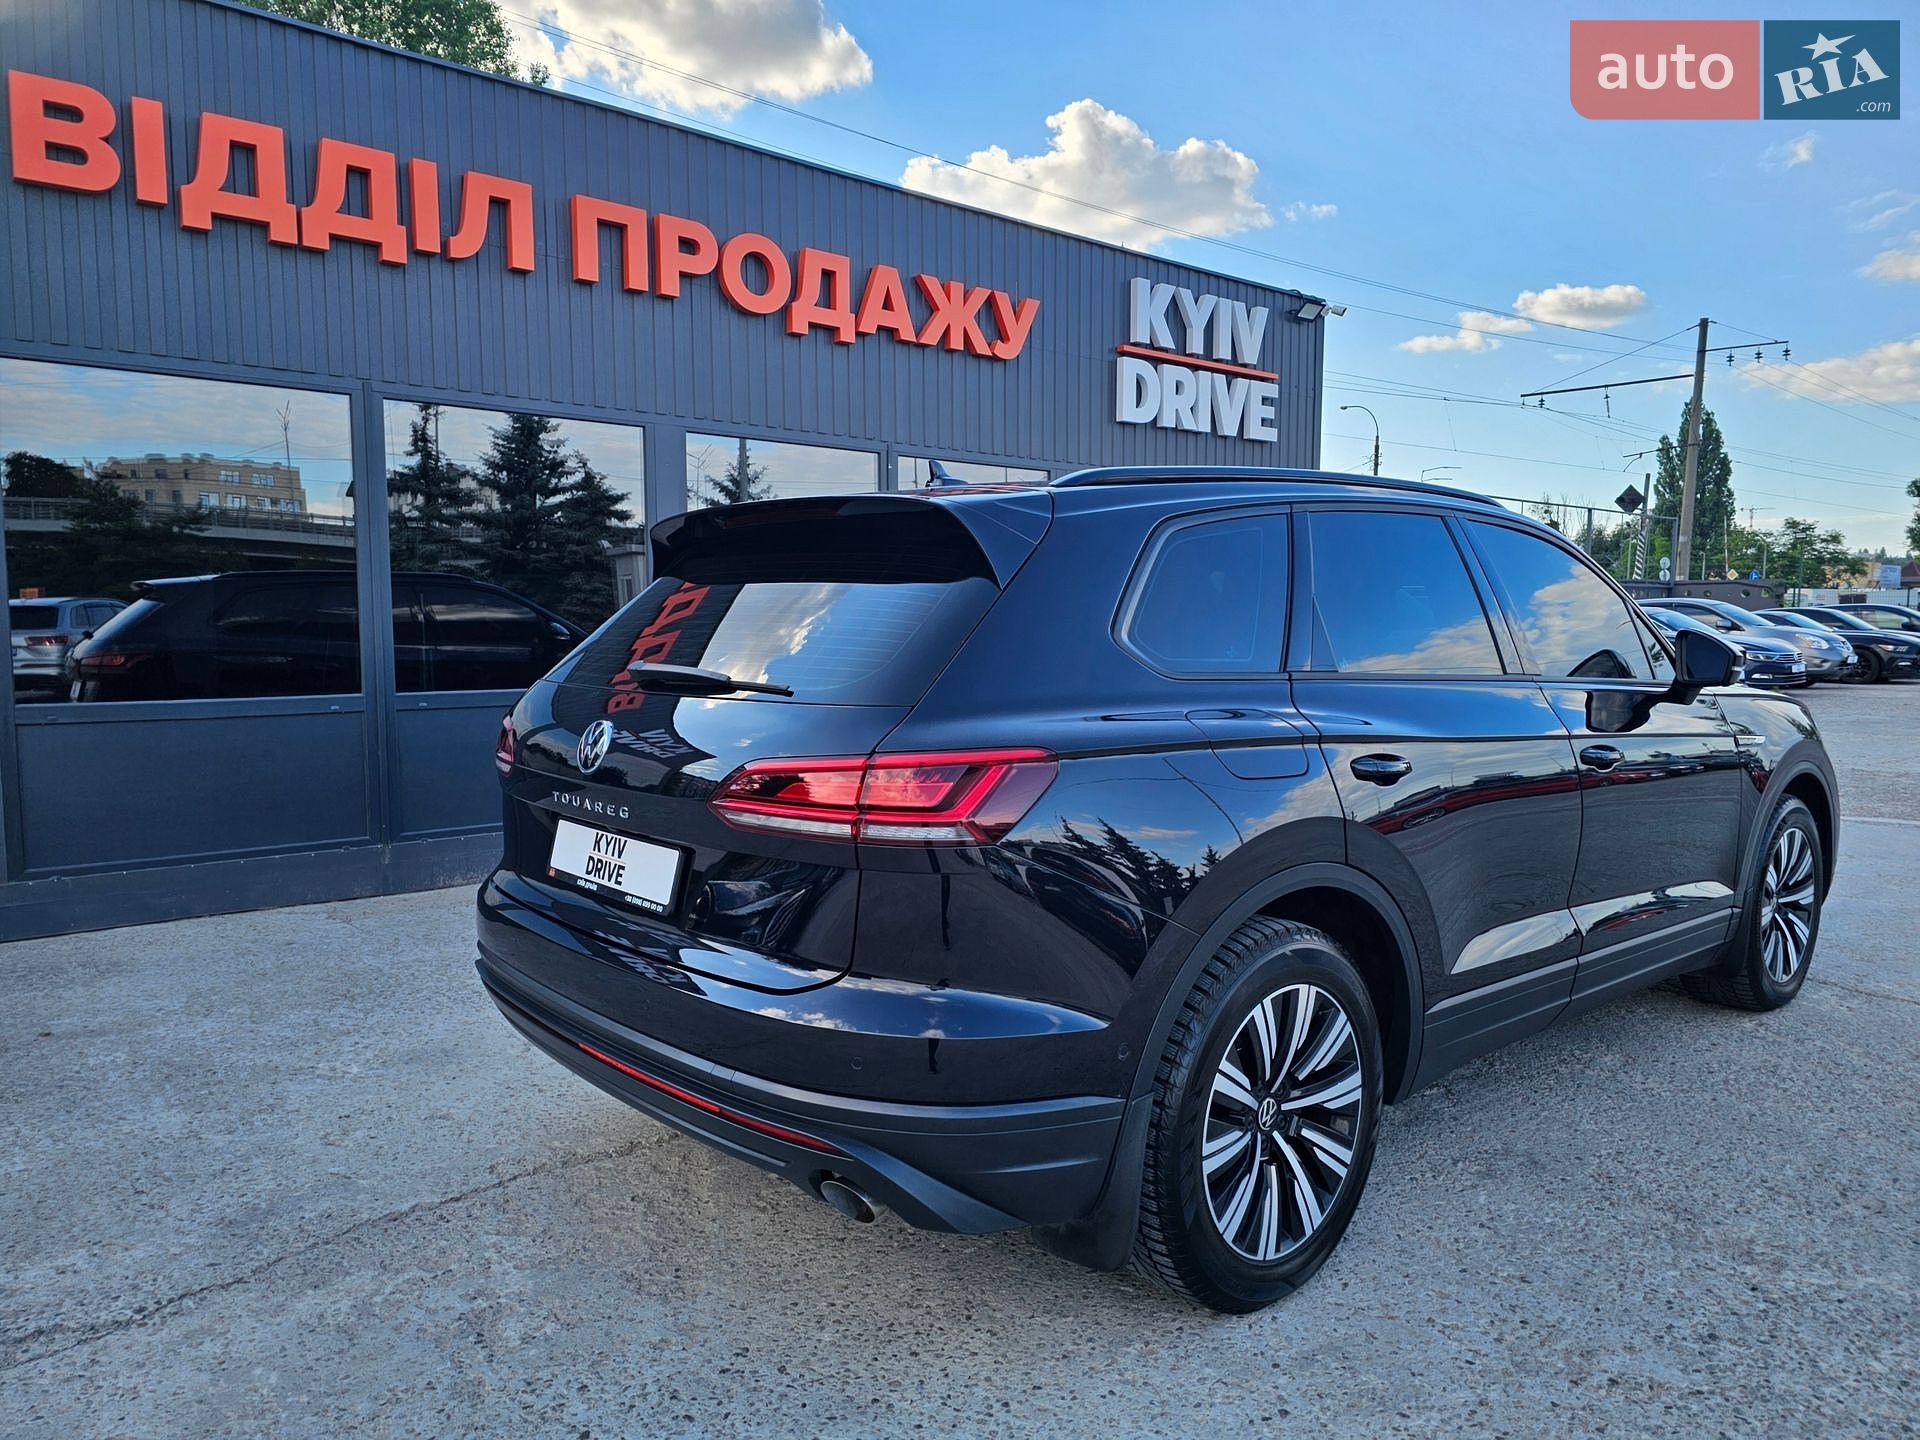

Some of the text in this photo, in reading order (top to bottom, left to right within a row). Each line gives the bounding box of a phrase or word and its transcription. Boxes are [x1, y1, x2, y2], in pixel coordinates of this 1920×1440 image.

[8, 69, 1040, 360] ВІДДІЛ ПРОДАЖУ
[1128, 276, 1269, 367] KYIV
[1115, 355, 1279, 442] DRIVE
[552, 790, 630, 819] TOUAREG
[585, 855, 626, 887] DRIVE
[593, 831, 628, 859] KYIV
